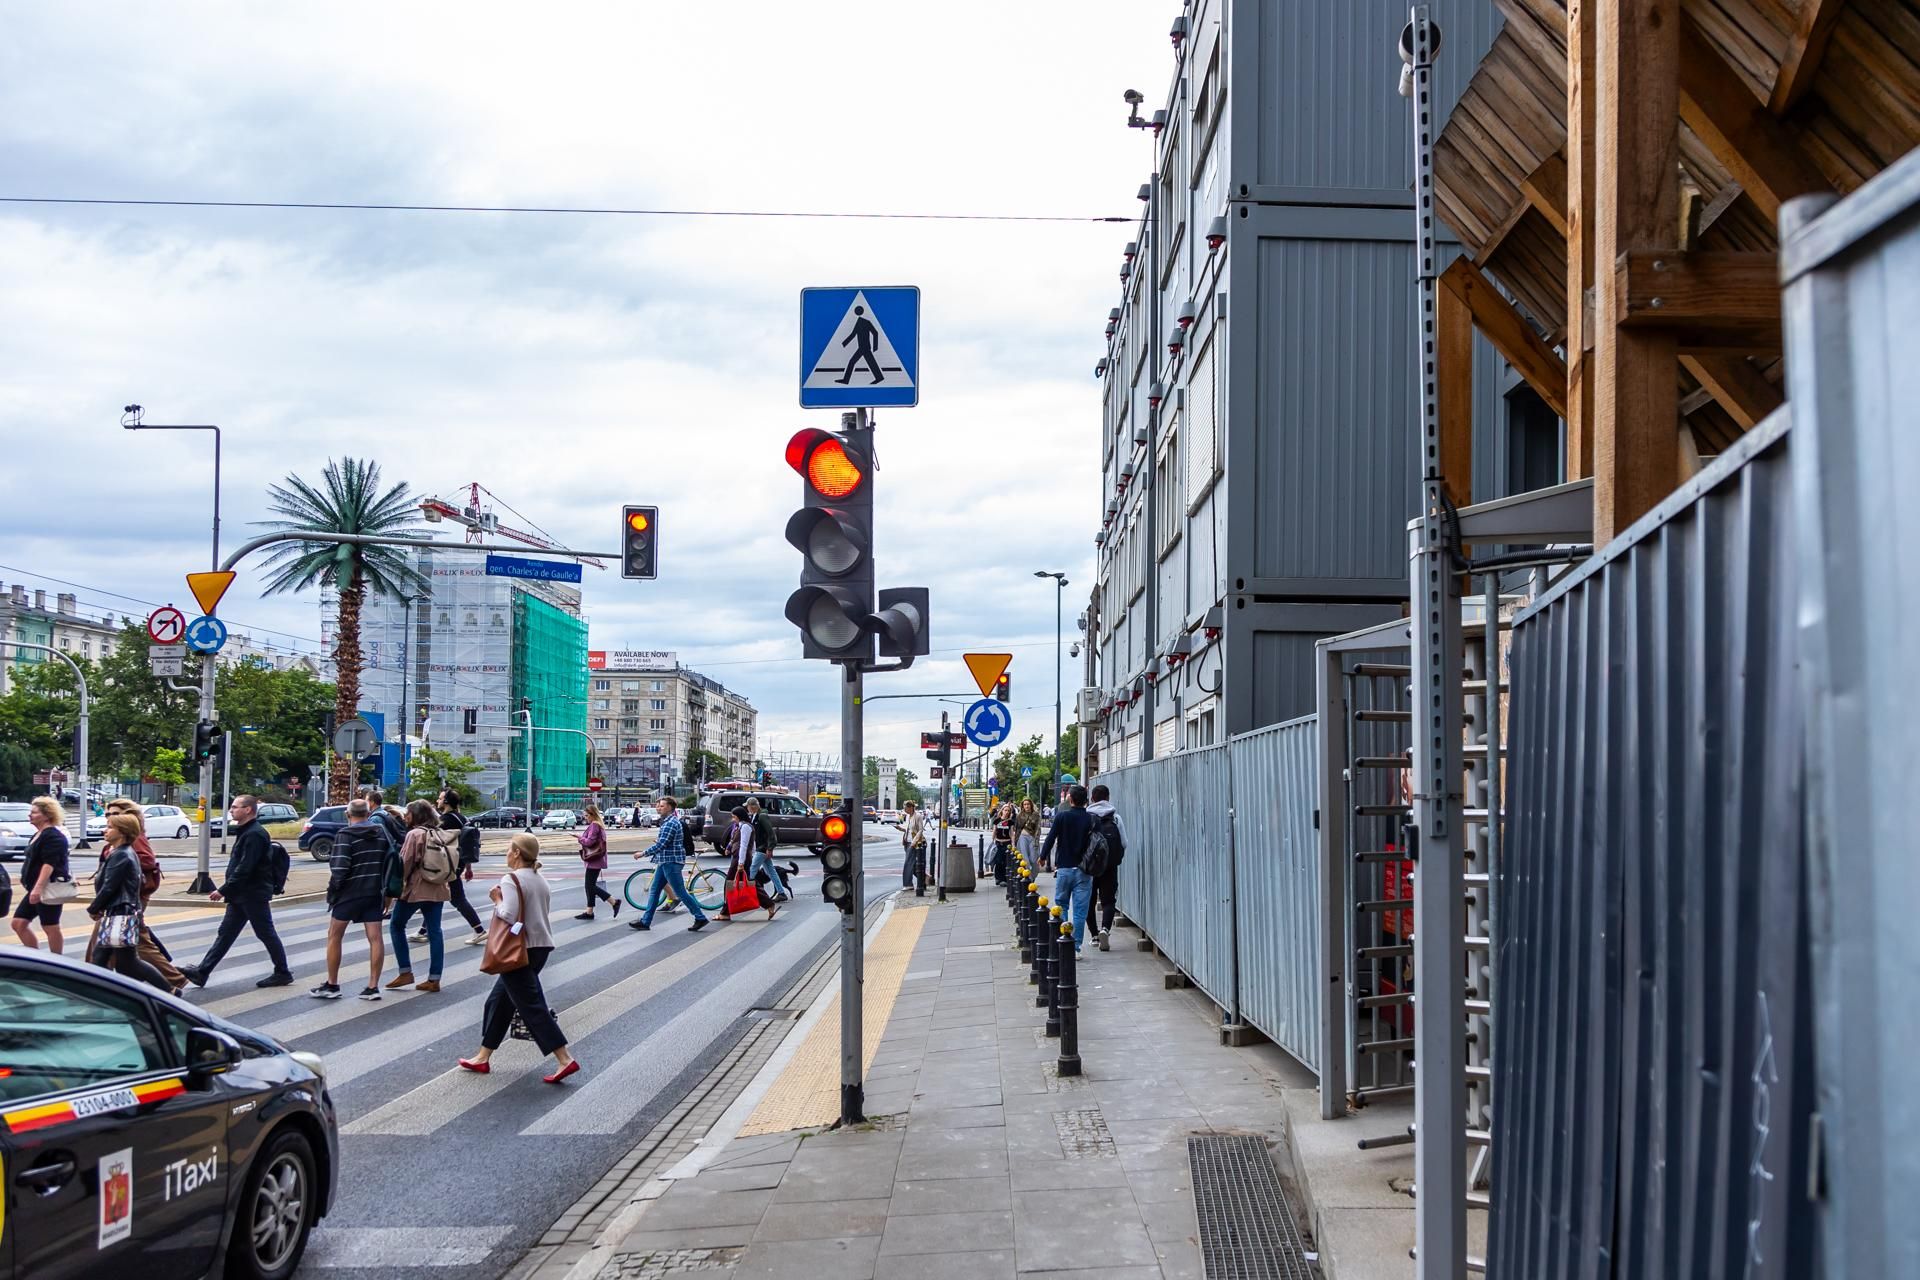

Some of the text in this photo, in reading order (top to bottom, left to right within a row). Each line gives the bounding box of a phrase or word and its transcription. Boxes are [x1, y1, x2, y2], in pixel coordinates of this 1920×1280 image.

[507, 565, 539, 577] Charles'a
[540, 569, 550, 577] de
[551, 571, 579, 580] Gaulle'a
[77, 1093, 134, 1115] 23104-0001
[165, 1145, 217, 1202] iTaxi
